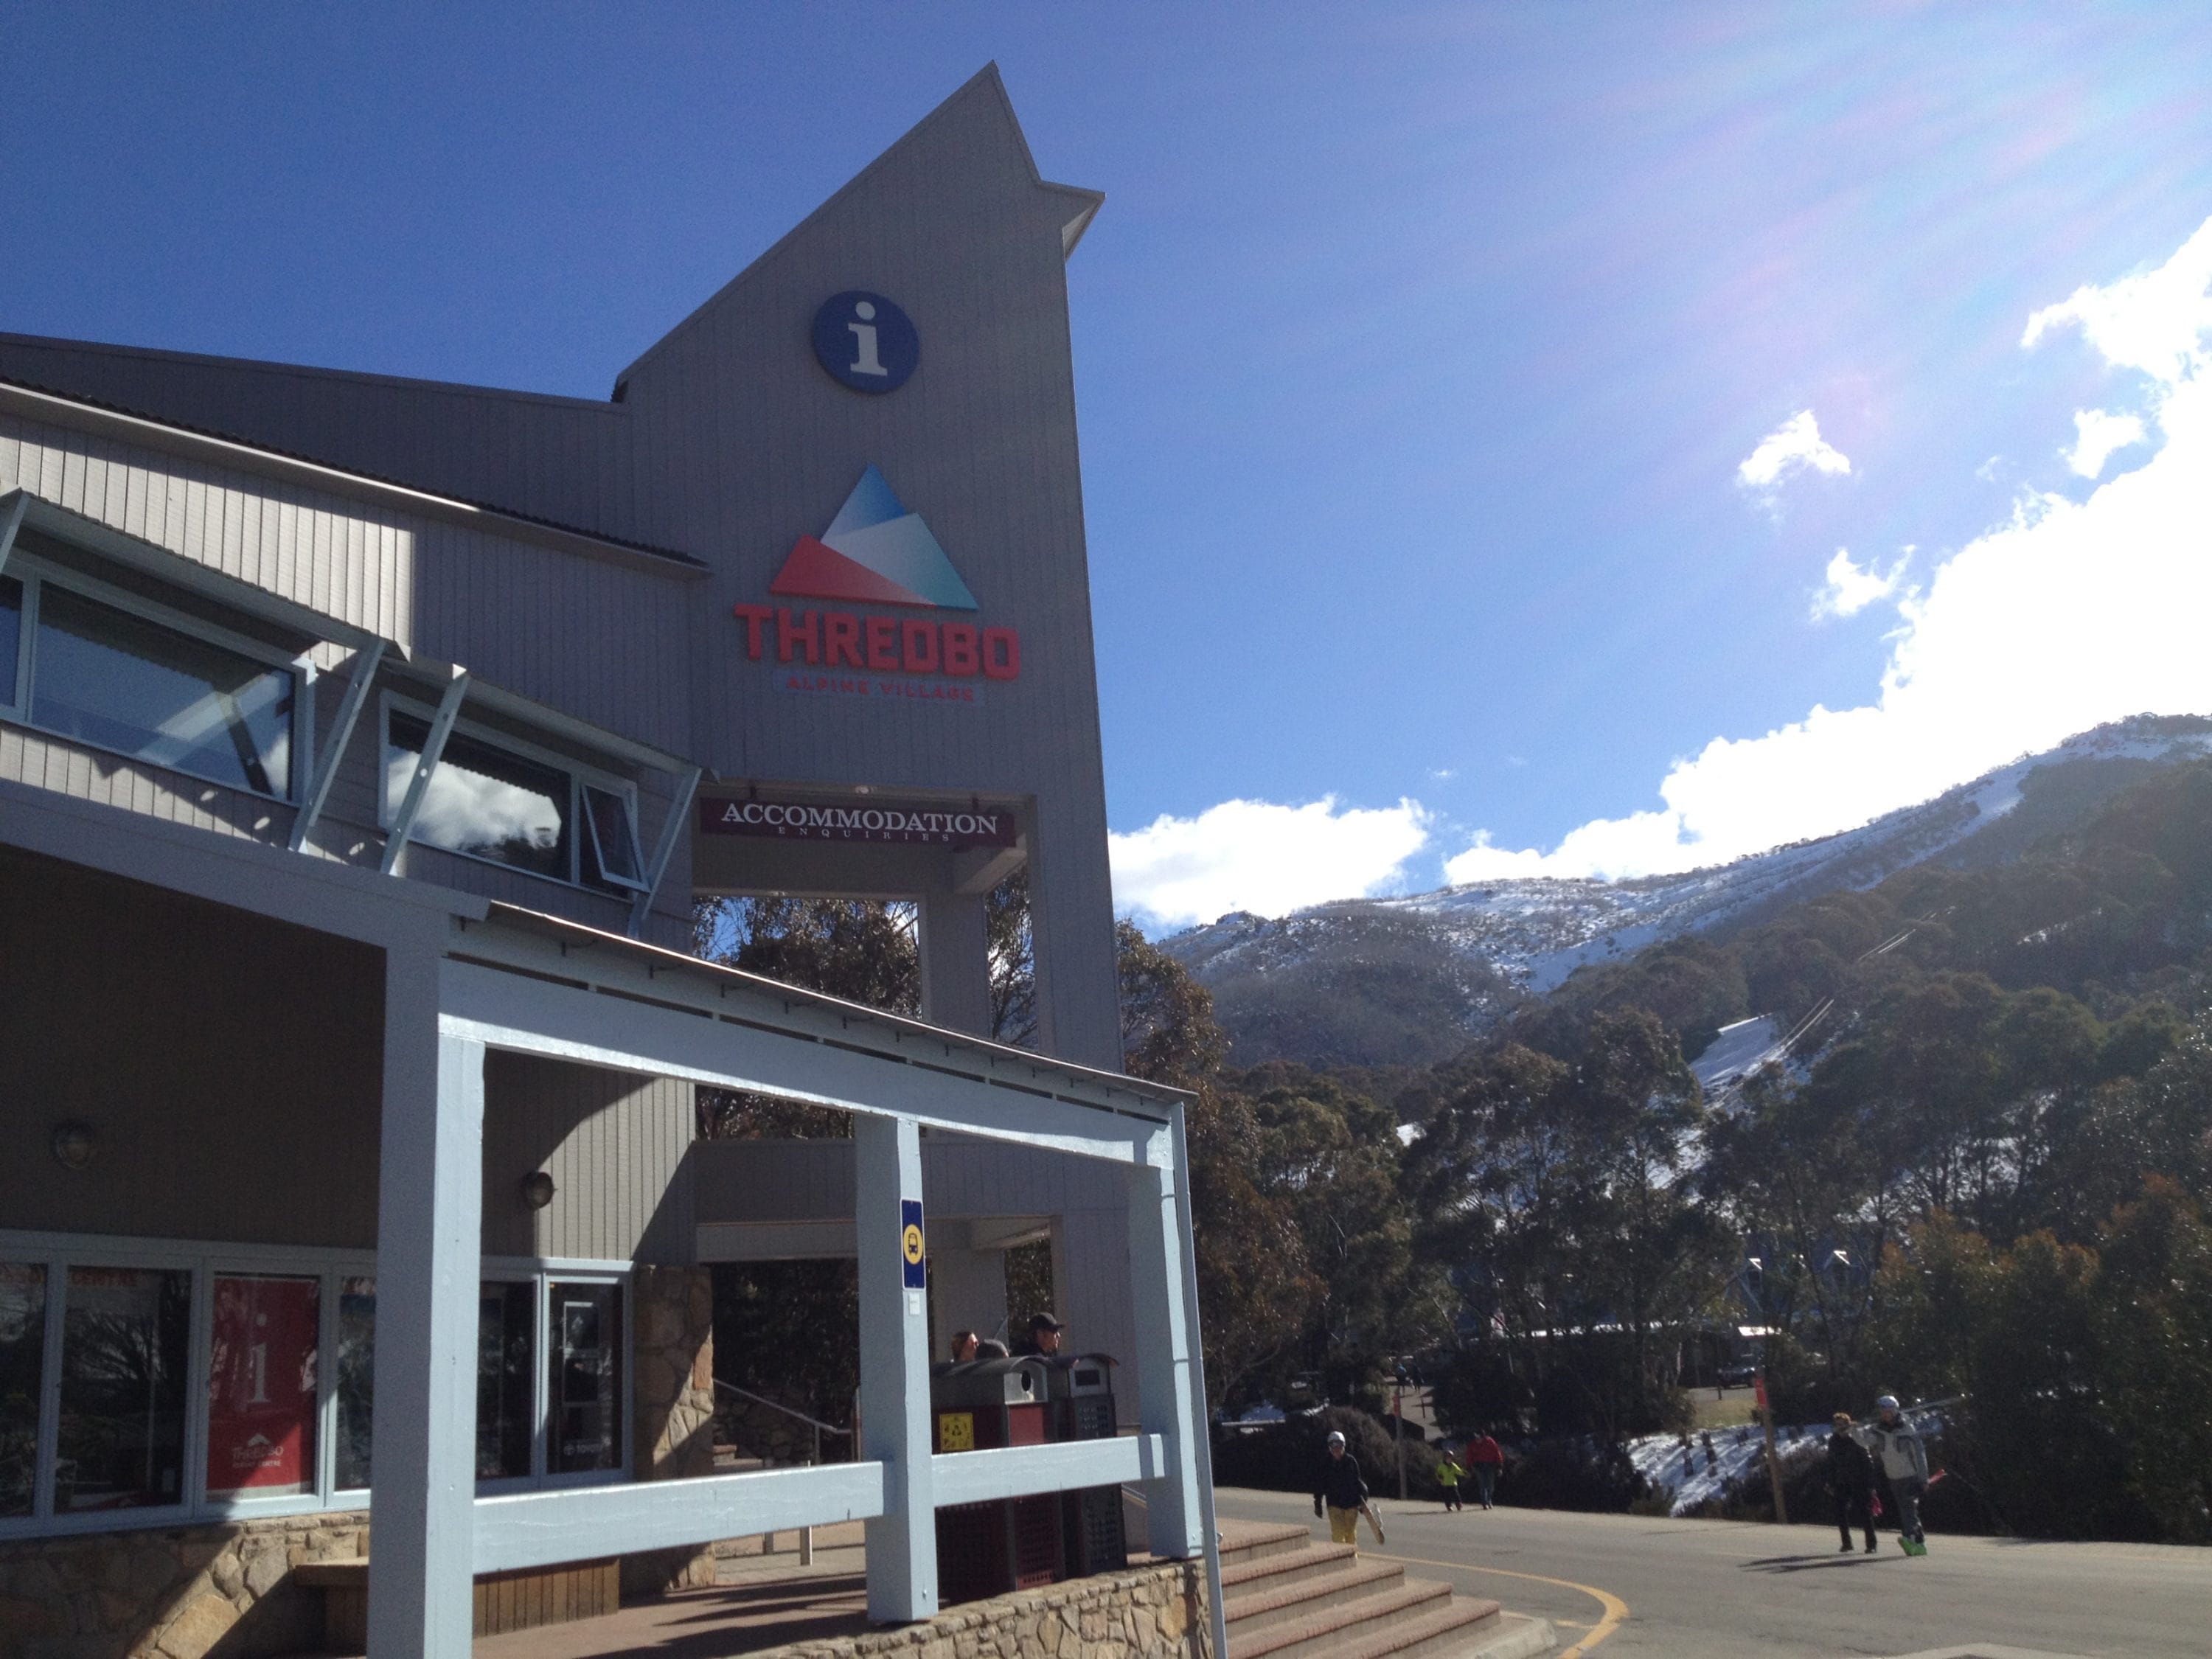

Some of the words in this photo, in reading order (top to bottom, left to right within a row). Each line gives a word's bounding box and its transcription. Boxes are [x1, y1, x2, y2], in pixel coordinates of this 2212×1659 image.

[847, 301, 888, 376] i
[734, 603, 1021, 681] THREDBO
[786, 675, 870, 695] ALPINE
[879, 681, 974, 702] VILLAGE
[721, 803, 998, 835] ACCOMMODATION
[779, 826, 949, 842] ENQUIRIES
